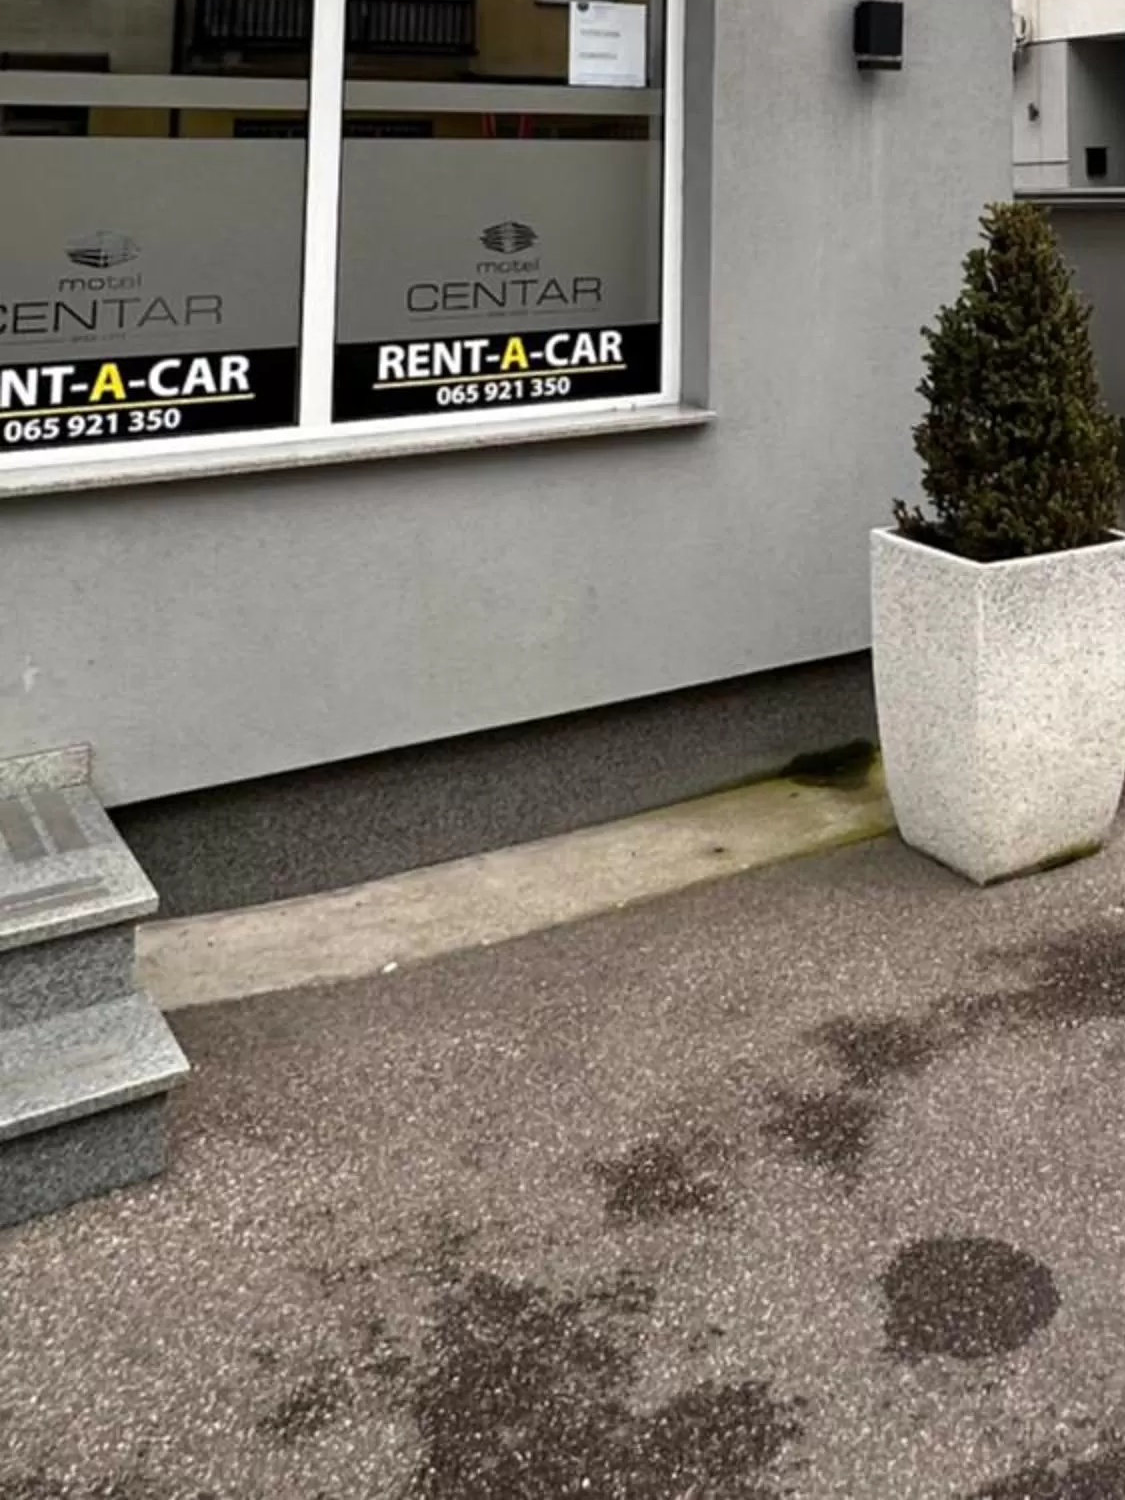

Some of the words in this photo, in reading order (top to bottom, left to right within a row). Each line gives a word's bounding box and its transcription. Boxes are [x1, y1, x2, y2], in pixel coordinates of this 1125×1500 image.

[58, 273, 142, 292] motel
[474, 259, 541, 273] motel
[406, 276, 602, 312] CENTAR
[378, 330, 623, 380] RENT-A-CAR
[436, 385, 479, 406] 065
[484, 380, 523, 401] 921
[530, 376, 571, 397] 350
[4, 417, 60, 443] 065
[67, 412, 118, 438] 921
[128, 407, 181, 433] 350
